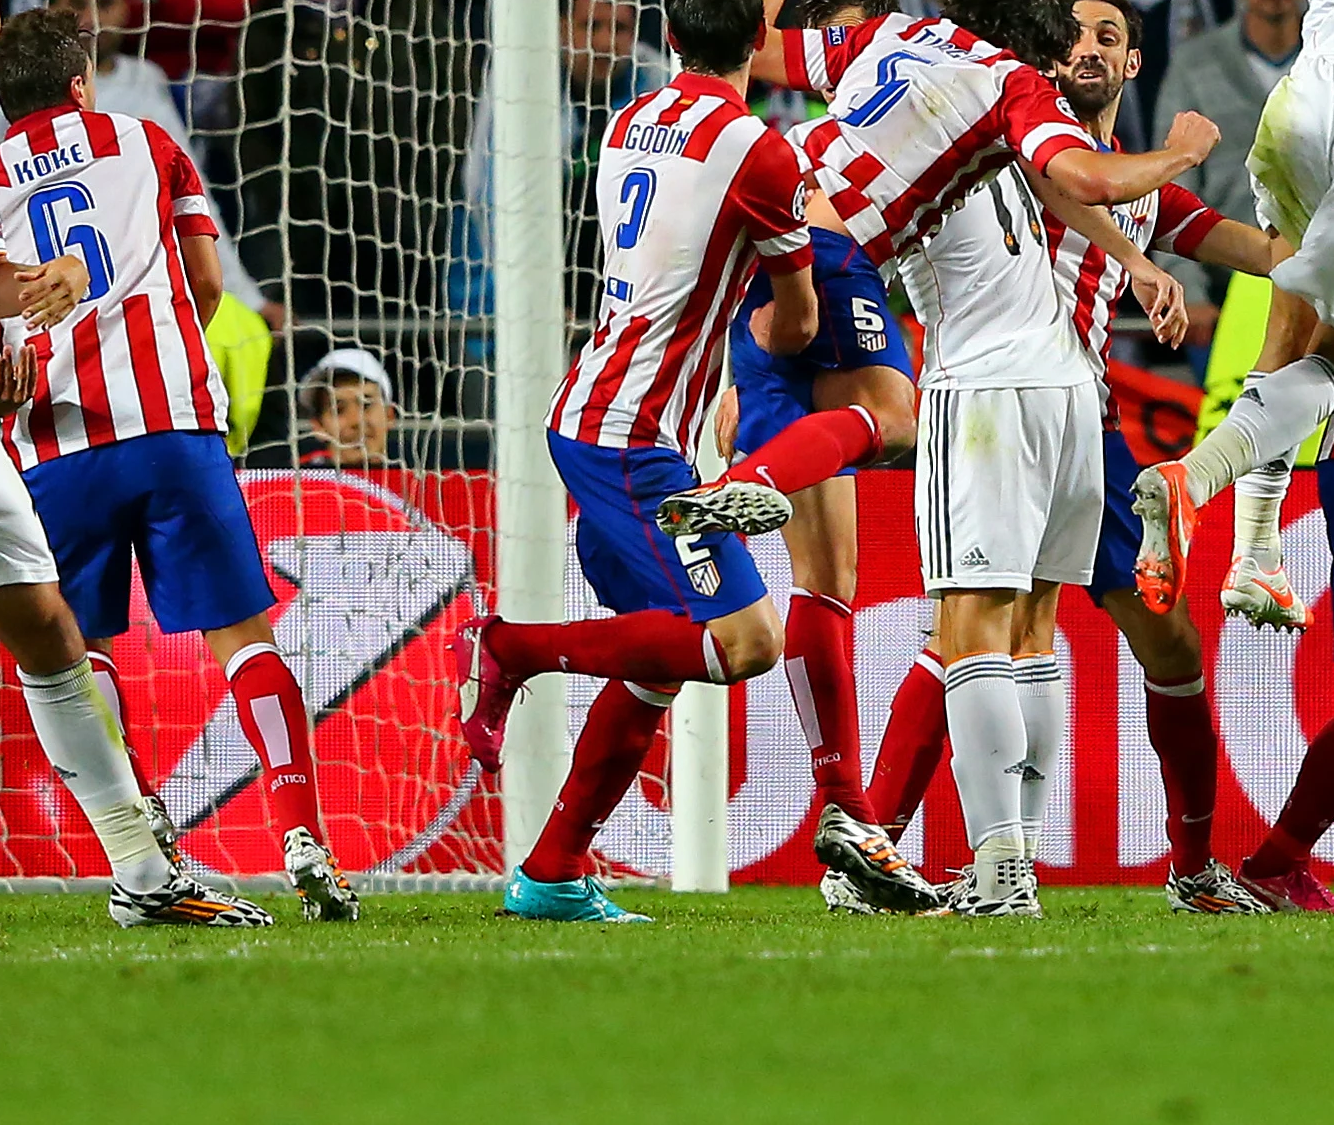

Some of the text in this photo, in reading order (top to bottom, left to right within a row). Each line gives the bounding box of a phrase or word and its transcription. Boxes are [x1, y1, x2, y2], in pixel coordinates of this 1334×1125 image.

[13, 143, 85, 185] KOKE
[27, 181, 115, 304] 6
[851, 296, 885, 332] 5
